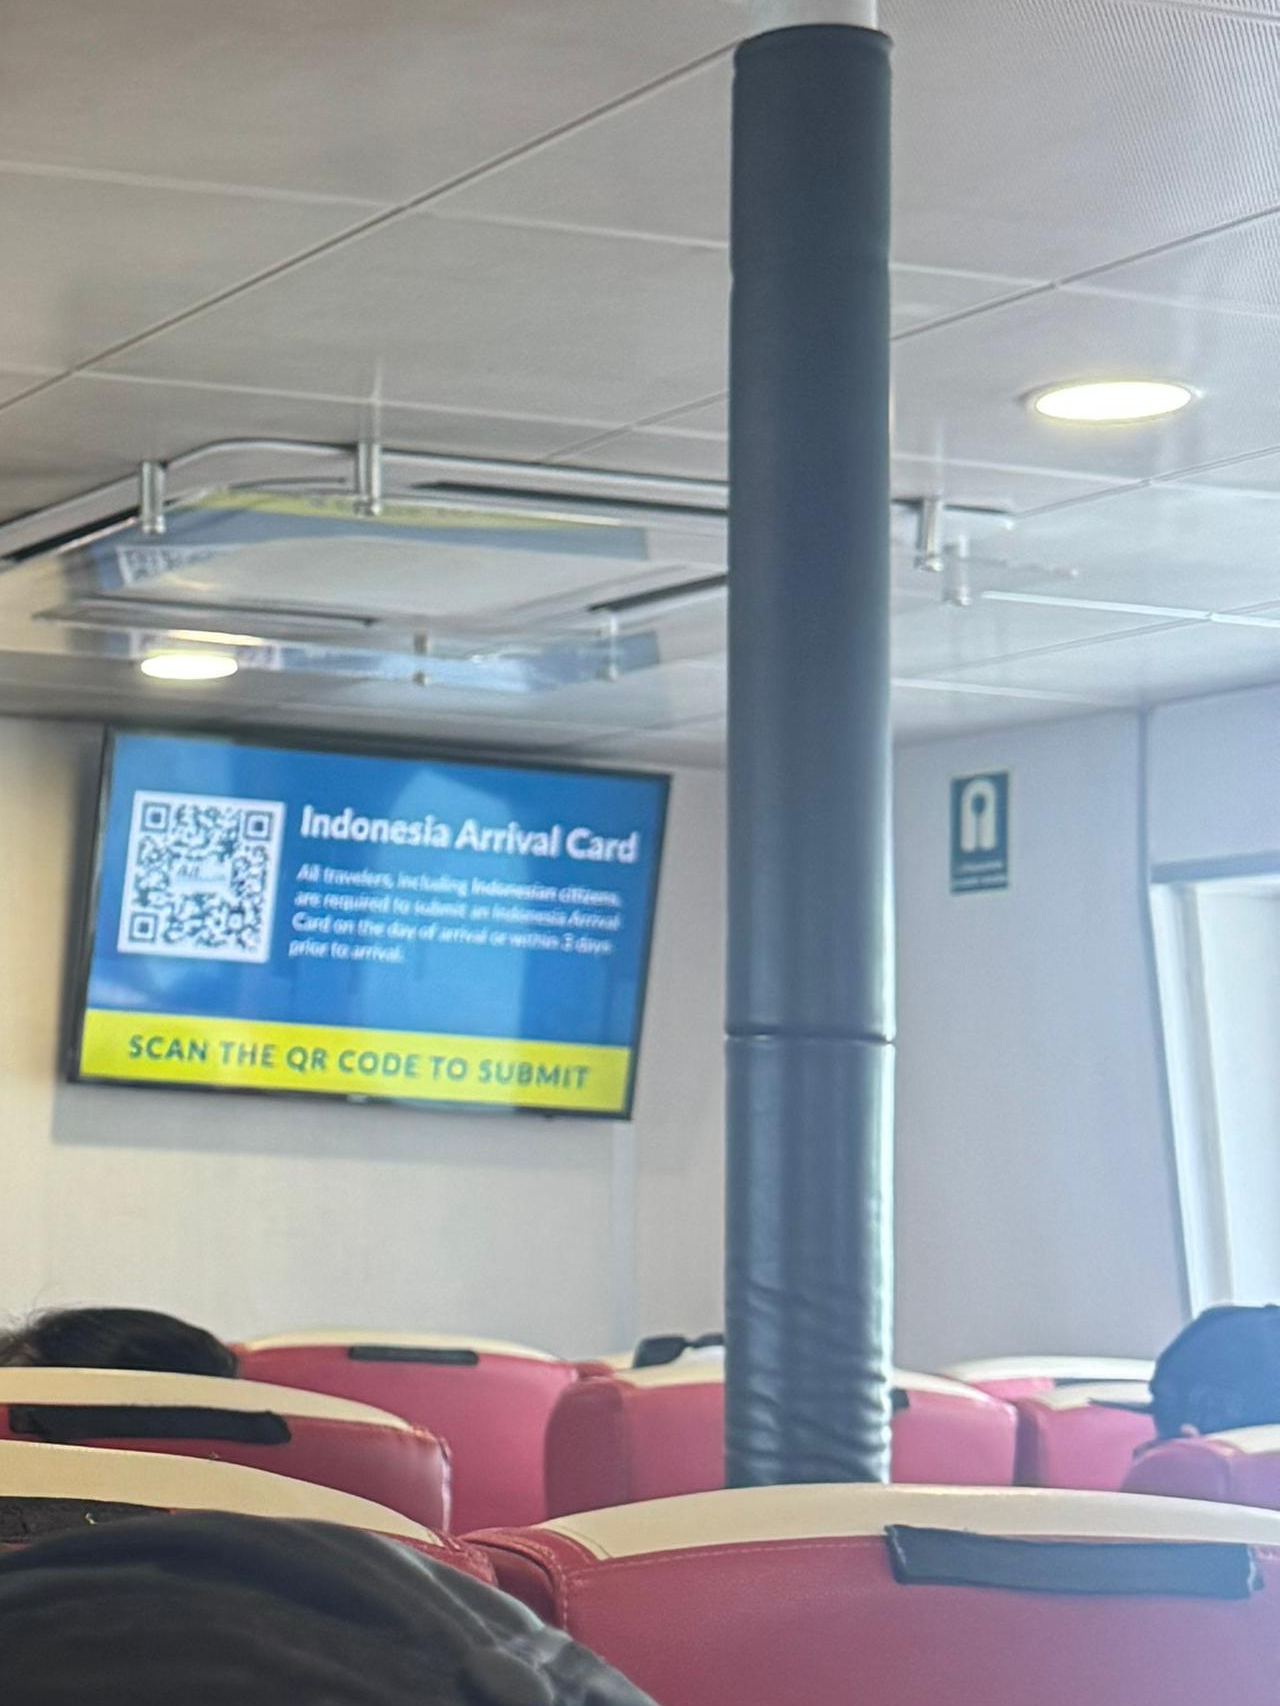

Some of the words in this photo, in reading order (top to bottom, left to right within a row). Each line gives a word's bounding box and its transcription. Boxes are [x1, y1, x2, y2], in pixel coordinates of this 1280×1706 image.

[300, 804, 451, 848] Indonesia
[454, 819, 562, 858] Arrival
[565, 828, 639, 863] Card
[296, 864, 318, 882] All
[323, 866, 391, 890] travelers,
[397, 872, 468, 897] including
[471, 877, 556, 901] Indonesian
[558, 884, 621, 908] citizens,
[294, 893, 320, 907] are
[323, 892, 390, 914] required
[393, 897, 410, 914] to
[414, 899, 466, 918] submit
[471, 905, 489, 919] an
[492, 903, 566, 926] Indonesia
[568, 910, 620, 930] Arrival
[289, 940, 327, 959] prior
[331, 942, 349, 958] to
[351, 945, 403, 964] arrival.
[292, 912, 329, 933] Card
[333, 919, 355, 933] on
[358, 918, 383, 935] the
[386, 920, 416, 941] day
[419, 922, 437, 940] of
[440, 925, 488, 943] arrival
[490, 930, 507, 945] or
[510, 929, 560, 950] within
[563, 933, 573, 951] 3
[575, 935, 611, 956] days
[128, 1034, 206, 1062] SCAN
[220, 1041, 275, 1067] THE
[287, 1046, 328, 1073] QR
[339, 1049, 418, 1077] CODE
[429, 1055, 467, 1080] TO
[479, 1060, 590, 1088] SUBMIT
